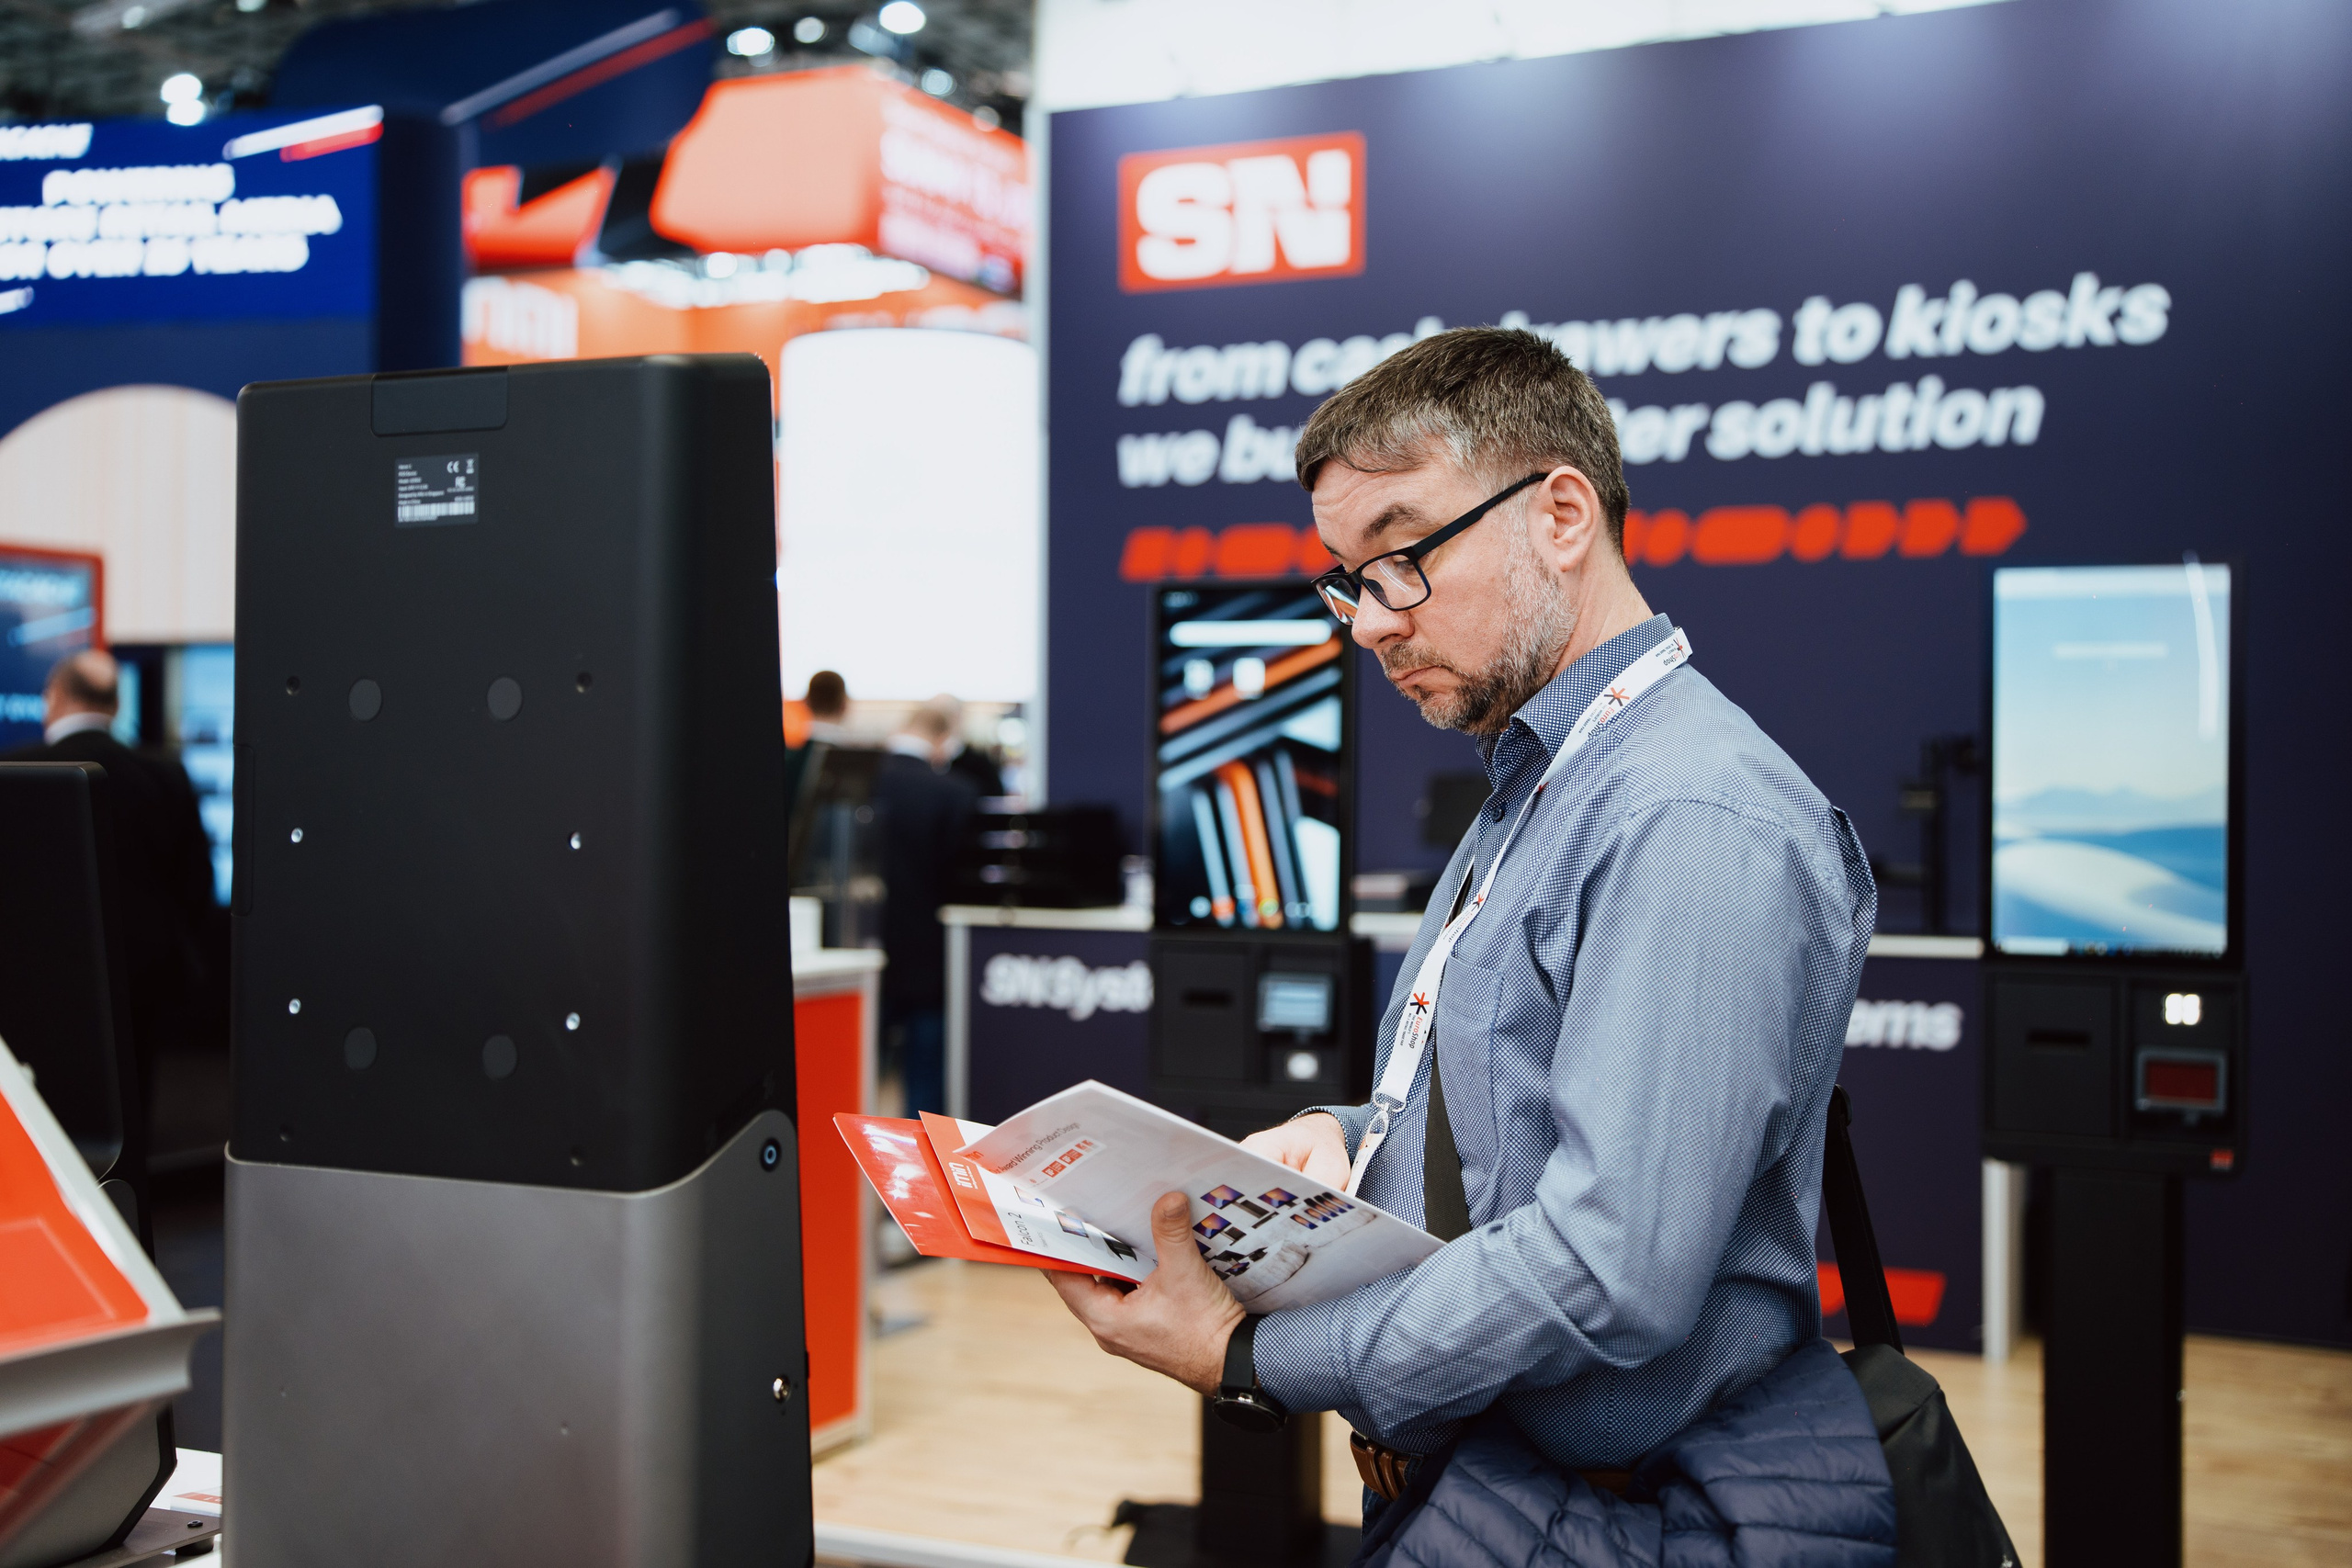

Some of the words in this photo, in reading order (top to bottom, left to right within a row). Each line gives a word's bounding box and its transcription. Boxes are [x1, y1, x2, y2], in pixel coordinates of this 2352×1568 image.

[1136, 148, 1351, 281] SN
[1117, 333, 1290, 407] from
[1792, 295, 1883, 367] to
[1884, 272, 2172, 359] kiosks
[1116, 428, 1221, 489] we
[1705, 374, 2045, 460] solution
[1408, 1016, 1423, 1049] EuroShop
[997, 1157, 1018, 1173] Award
[1014, 1144, 1043, 1164] Winning
[1035, 1128, 1059, 1145] Product
[1015, 1220, 1035, 1247] Falcon
